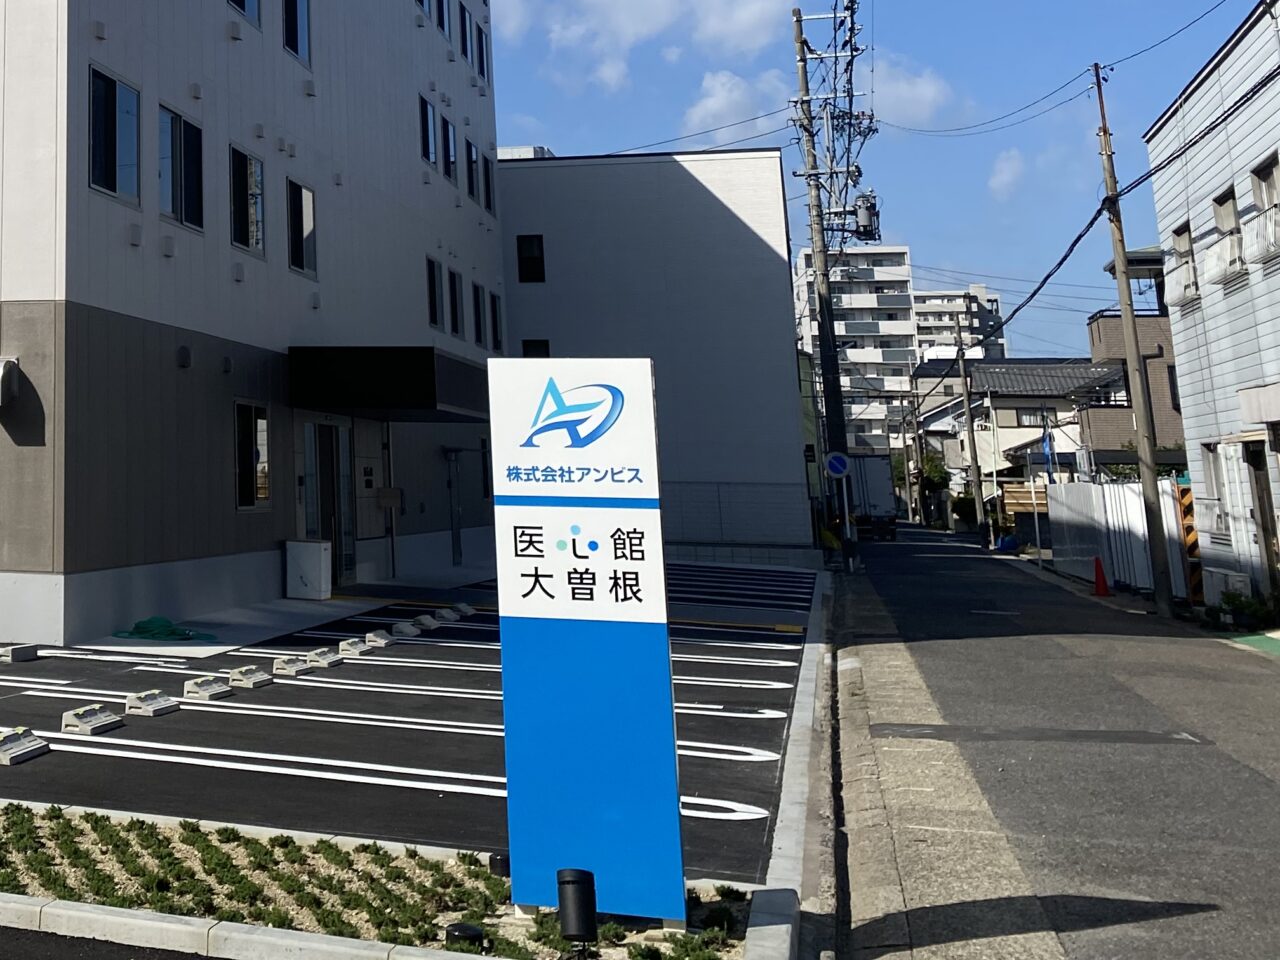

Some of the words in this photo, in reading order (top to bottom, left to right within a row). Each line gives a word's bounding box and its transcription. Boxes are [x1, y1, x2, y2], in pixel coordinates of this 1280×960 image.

[506, 466, 643, 483] 株式会社アンビス
[513, 525, 645, 561] 医心館
[521, 567, 643, 603] 大曽根
